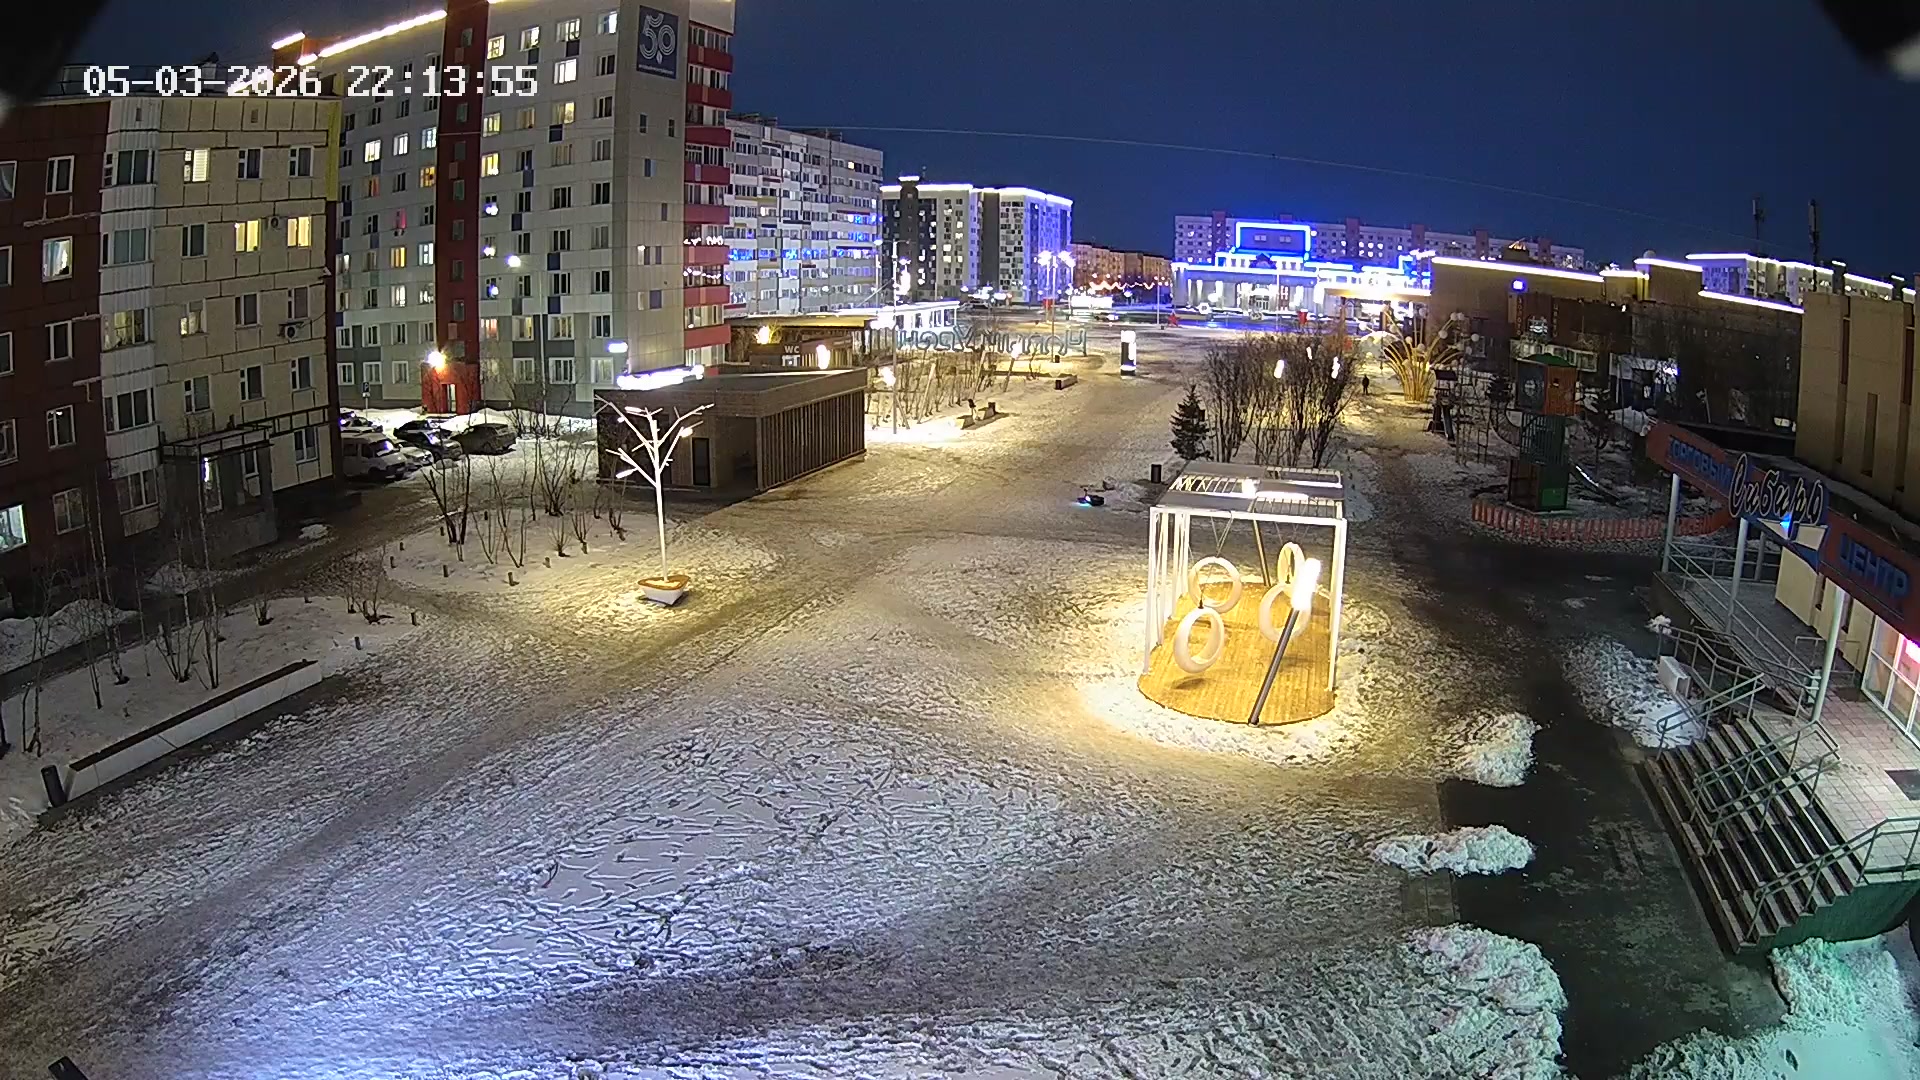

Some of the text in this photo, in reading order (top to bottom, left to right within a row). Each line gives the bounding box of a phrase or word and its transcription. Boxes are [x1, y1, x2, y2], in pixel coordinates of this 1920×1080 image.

[640, 13, 676, 60] 50
[784, 345, 800, 354] WC
[1729, 453, 1824, 538] Сибирь
[1840, 532, 1910, 598] ЦЕНТР
